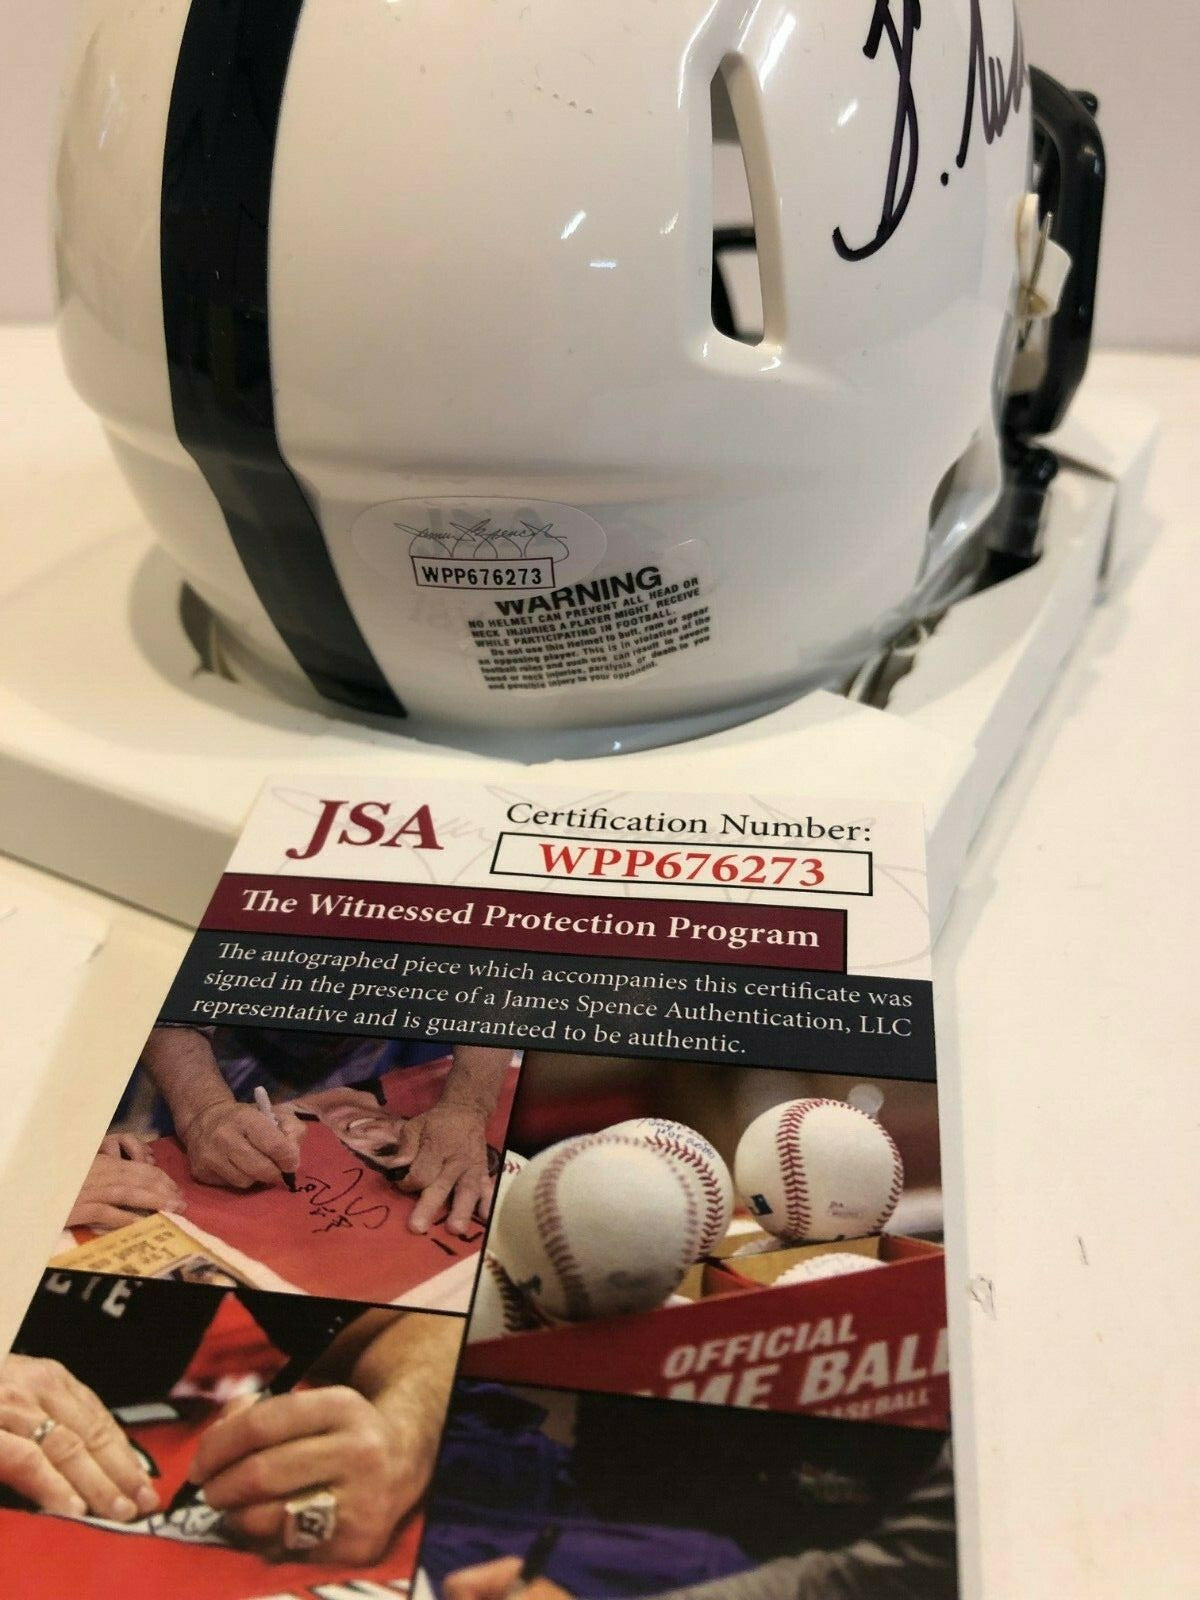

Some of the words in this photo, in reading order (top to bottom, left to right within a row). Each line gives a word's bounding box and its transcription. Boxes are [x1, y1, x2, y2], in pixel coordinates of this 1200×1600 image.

[421, 565, 542, 586] WPP676273
[495, 566, 661, 616] WARNING
[468, 620, 484, 628] NO
[488, 616, 533, 628] HELMET
[538, 613, 561, 623] CAN
[565, 601, 617, 619] PREVENT
[623, 595, 644, 607] ALL
[648, 584, 679, 600] HEAD
[683, 577, 699, 589] OR
[471, 630, 500, 638] NECK
[506, 624, 556, 636] INJURIES
[560, 622, 567, 630] A
[570, 614, 611, 628] PLAYER
[614, 604, 649, 619] MIGHT
[656, 588, 700, 608] RECEIVE
[475, 639, 510, 648] WHILE
[513, 627, 597, 645] PARTICIPATING
[600, 624, 612, 633] IN
[567, 636, 604, 649] Helmet
[285, 799, 444, 860] JSA
[506, 803, 708, 835] Certification
[720, 814, 871, 842] Number:
[539, 843, 825, 887] WPP676273
[242, 889, 298, 914] The
[309, 893, 472, 926] Witnessed
[482, 905, 656, 937] Protection
[667, 916, 820, 949] Program
[218, 942, 256, 960] The
[261, 949, 399, 972] autographed
[402, 957, 461, 976] piece
[469, 960, 534, 980] which
[542, 969, 687, 991] accompanies
[696, 975, 737, 994] this
[744, 981, 861, 1003] certificate
[868, 993, 913, 1007] was
[191, 999, 347, 1023] representative
[354, 1009, 398, 1027] and
[403, 1011, 420, 1028] is
[425, 1017, 556, 1039] guaranteed
[564, 1024, 586, 1041] to
[594, 1023, 621, 1044] be
[628, 1032, 746, 1054] authentic.
[204, 970, 277, 991] signed
[280, 974, 302, 991] in
[310, 976, 345, 994] the
[348, 981, 449, 1002] presence
[455, 987, 483, 1003] of
[484, 993, 495, 1005] a
[502, 989, 569, 1011] James
[576, 995, 657, 1018] Spence
[664, 1002, 851, 1033] Authentication,
[859, 1015, 912, 1038] LLC
[663, 1314, 858, 1379] OFFICIAL
